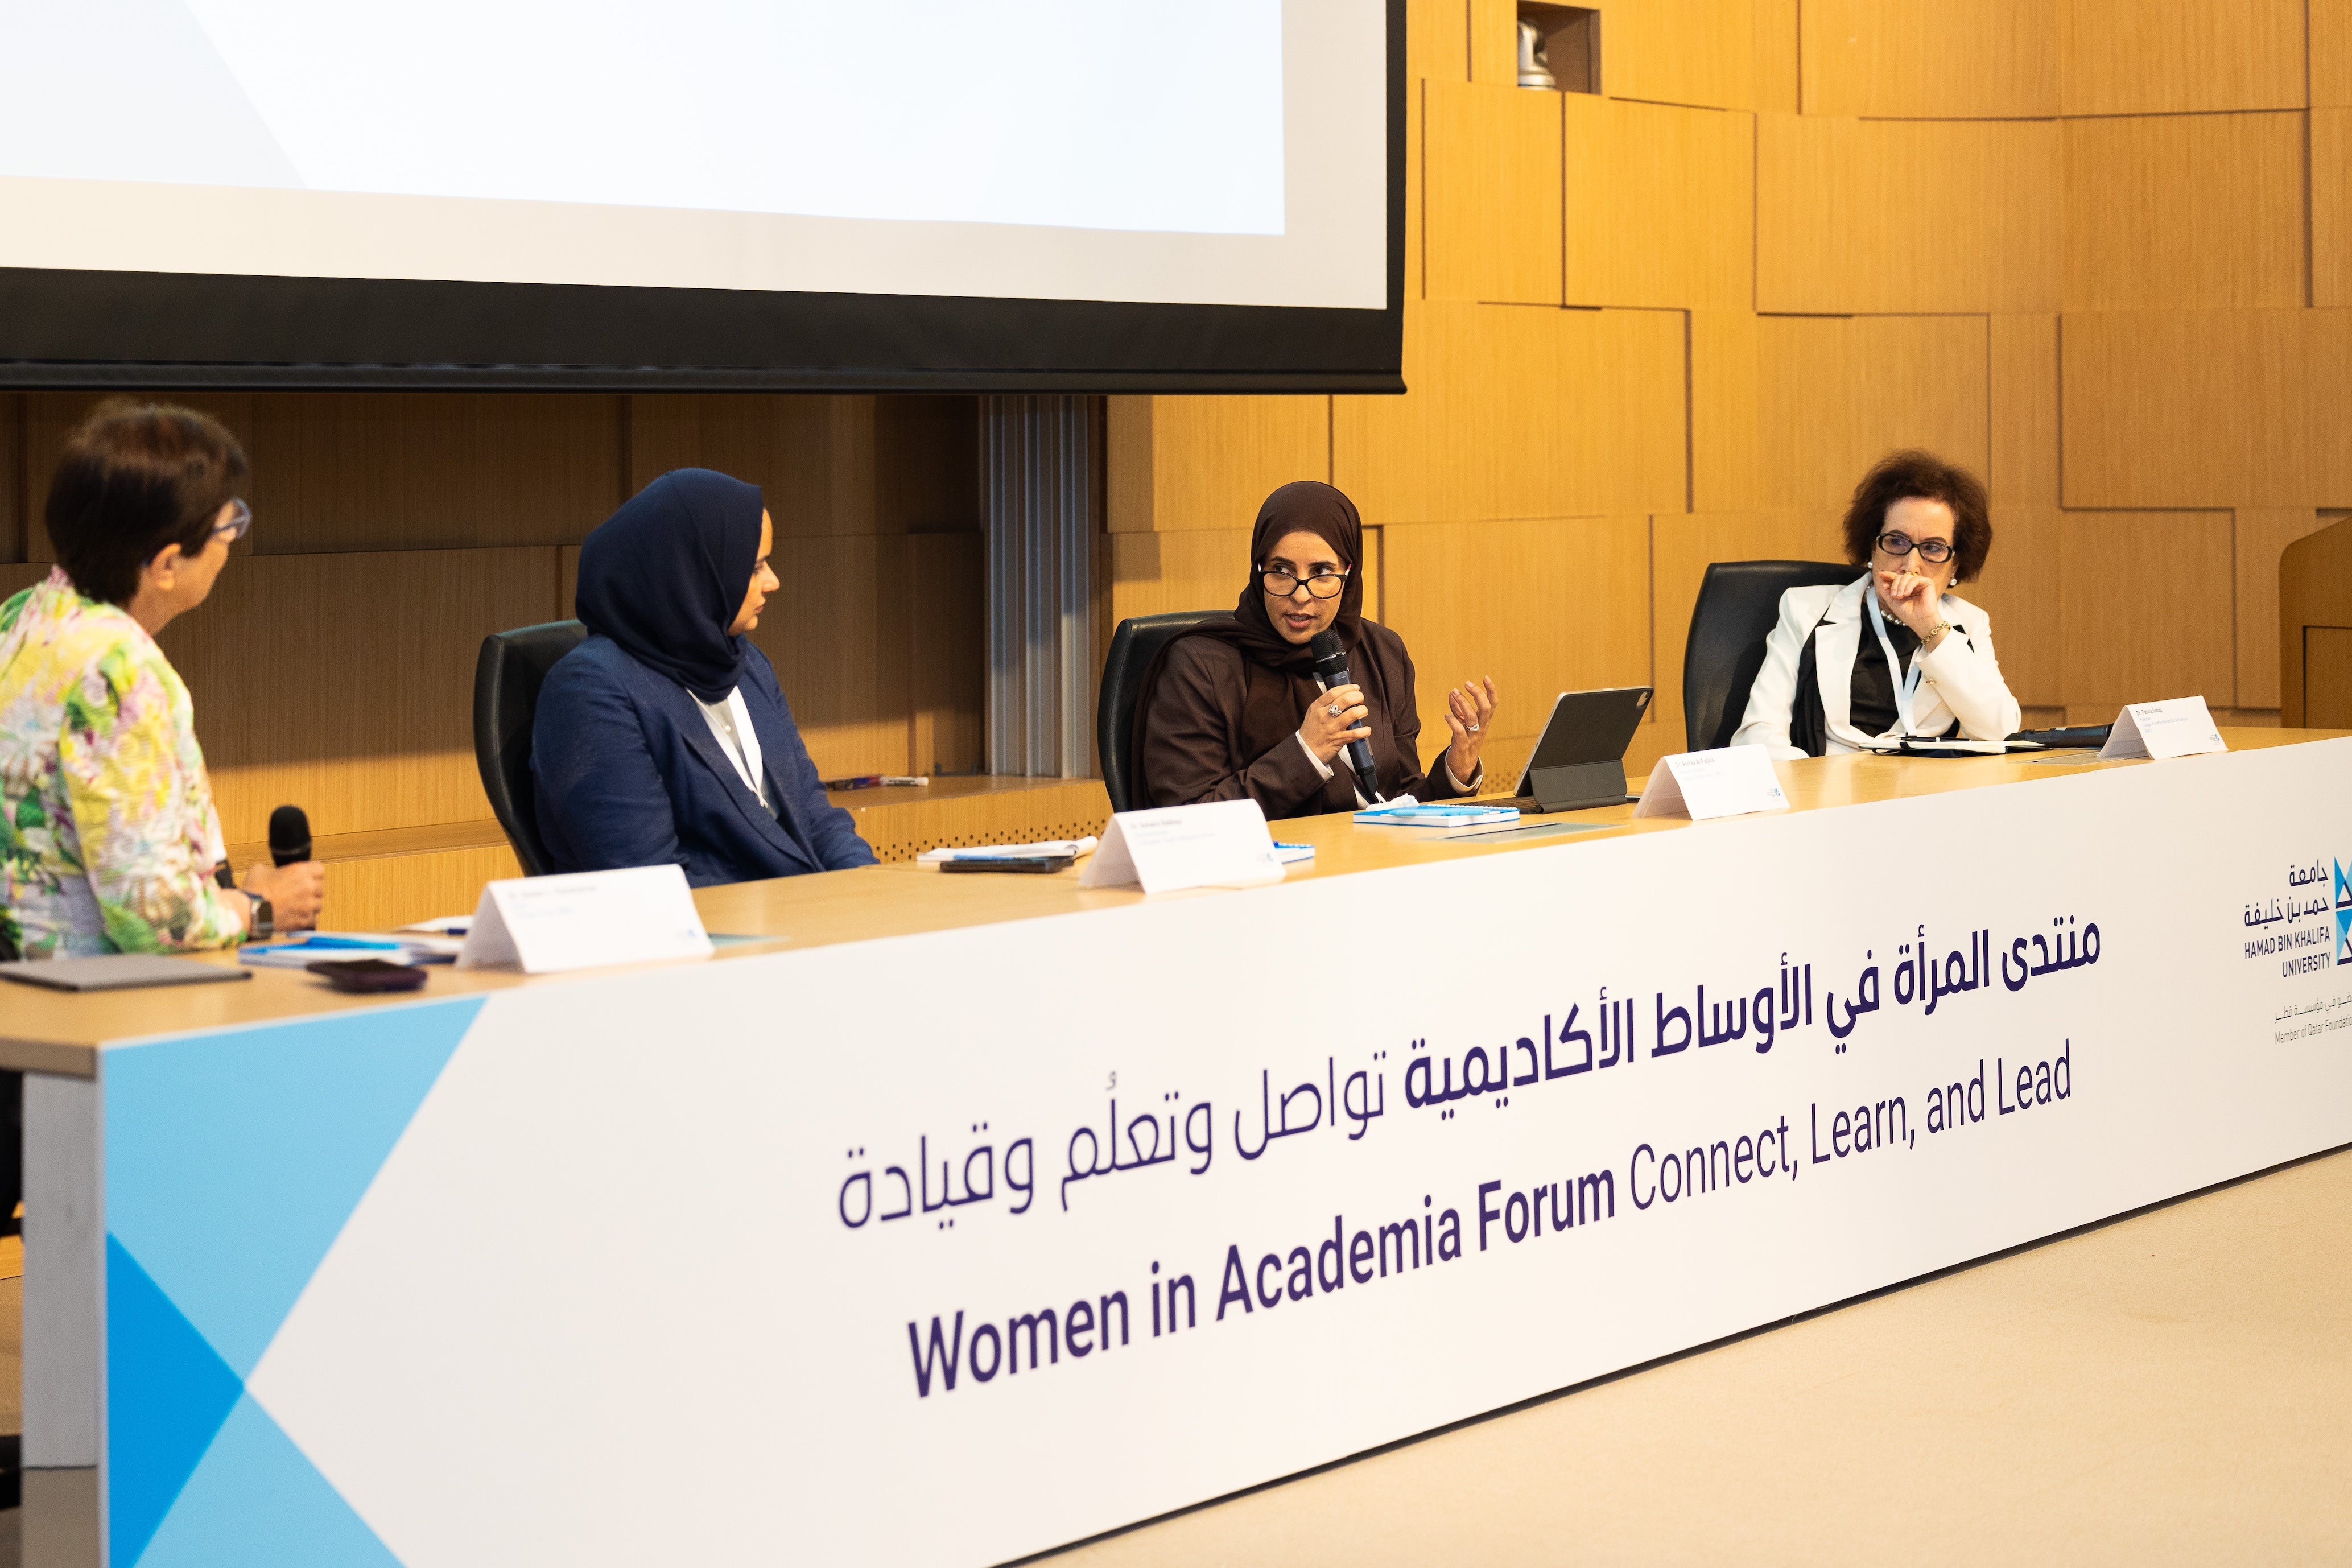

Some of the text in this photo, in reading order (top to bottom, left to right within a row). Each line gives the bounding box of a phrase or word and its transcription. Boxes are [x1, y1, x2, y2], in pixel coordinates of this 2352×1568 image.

[2244, 896, 2330, 930] حمد بن خليفة
[2289, 859, 2329, 887] جامعة
[1893, 924, 1990, 1016] المرأة
[2002, 915, 2101, 992] منتدى
[2245, 926, 2330, 959] HAMAD BIN KHALIFA
[2282, 951, 2330, 978] UNIVERSITY
[1651, 952, 1812, 1058] الأوساط
[1826, 949, 1879, 1055] في
[2275, 1014, 2352, 1045] Member of Qatar Foundatio
[1405, 986, 1635, 1121] الأكاديمية
[1235, 1050, 1387, 1161] تواصل
[839, 1122, 1034, 1229] وقيادة
[907, 1038, 2071, 1398] Women in Academia Forum Connect, Learn, and Lead
